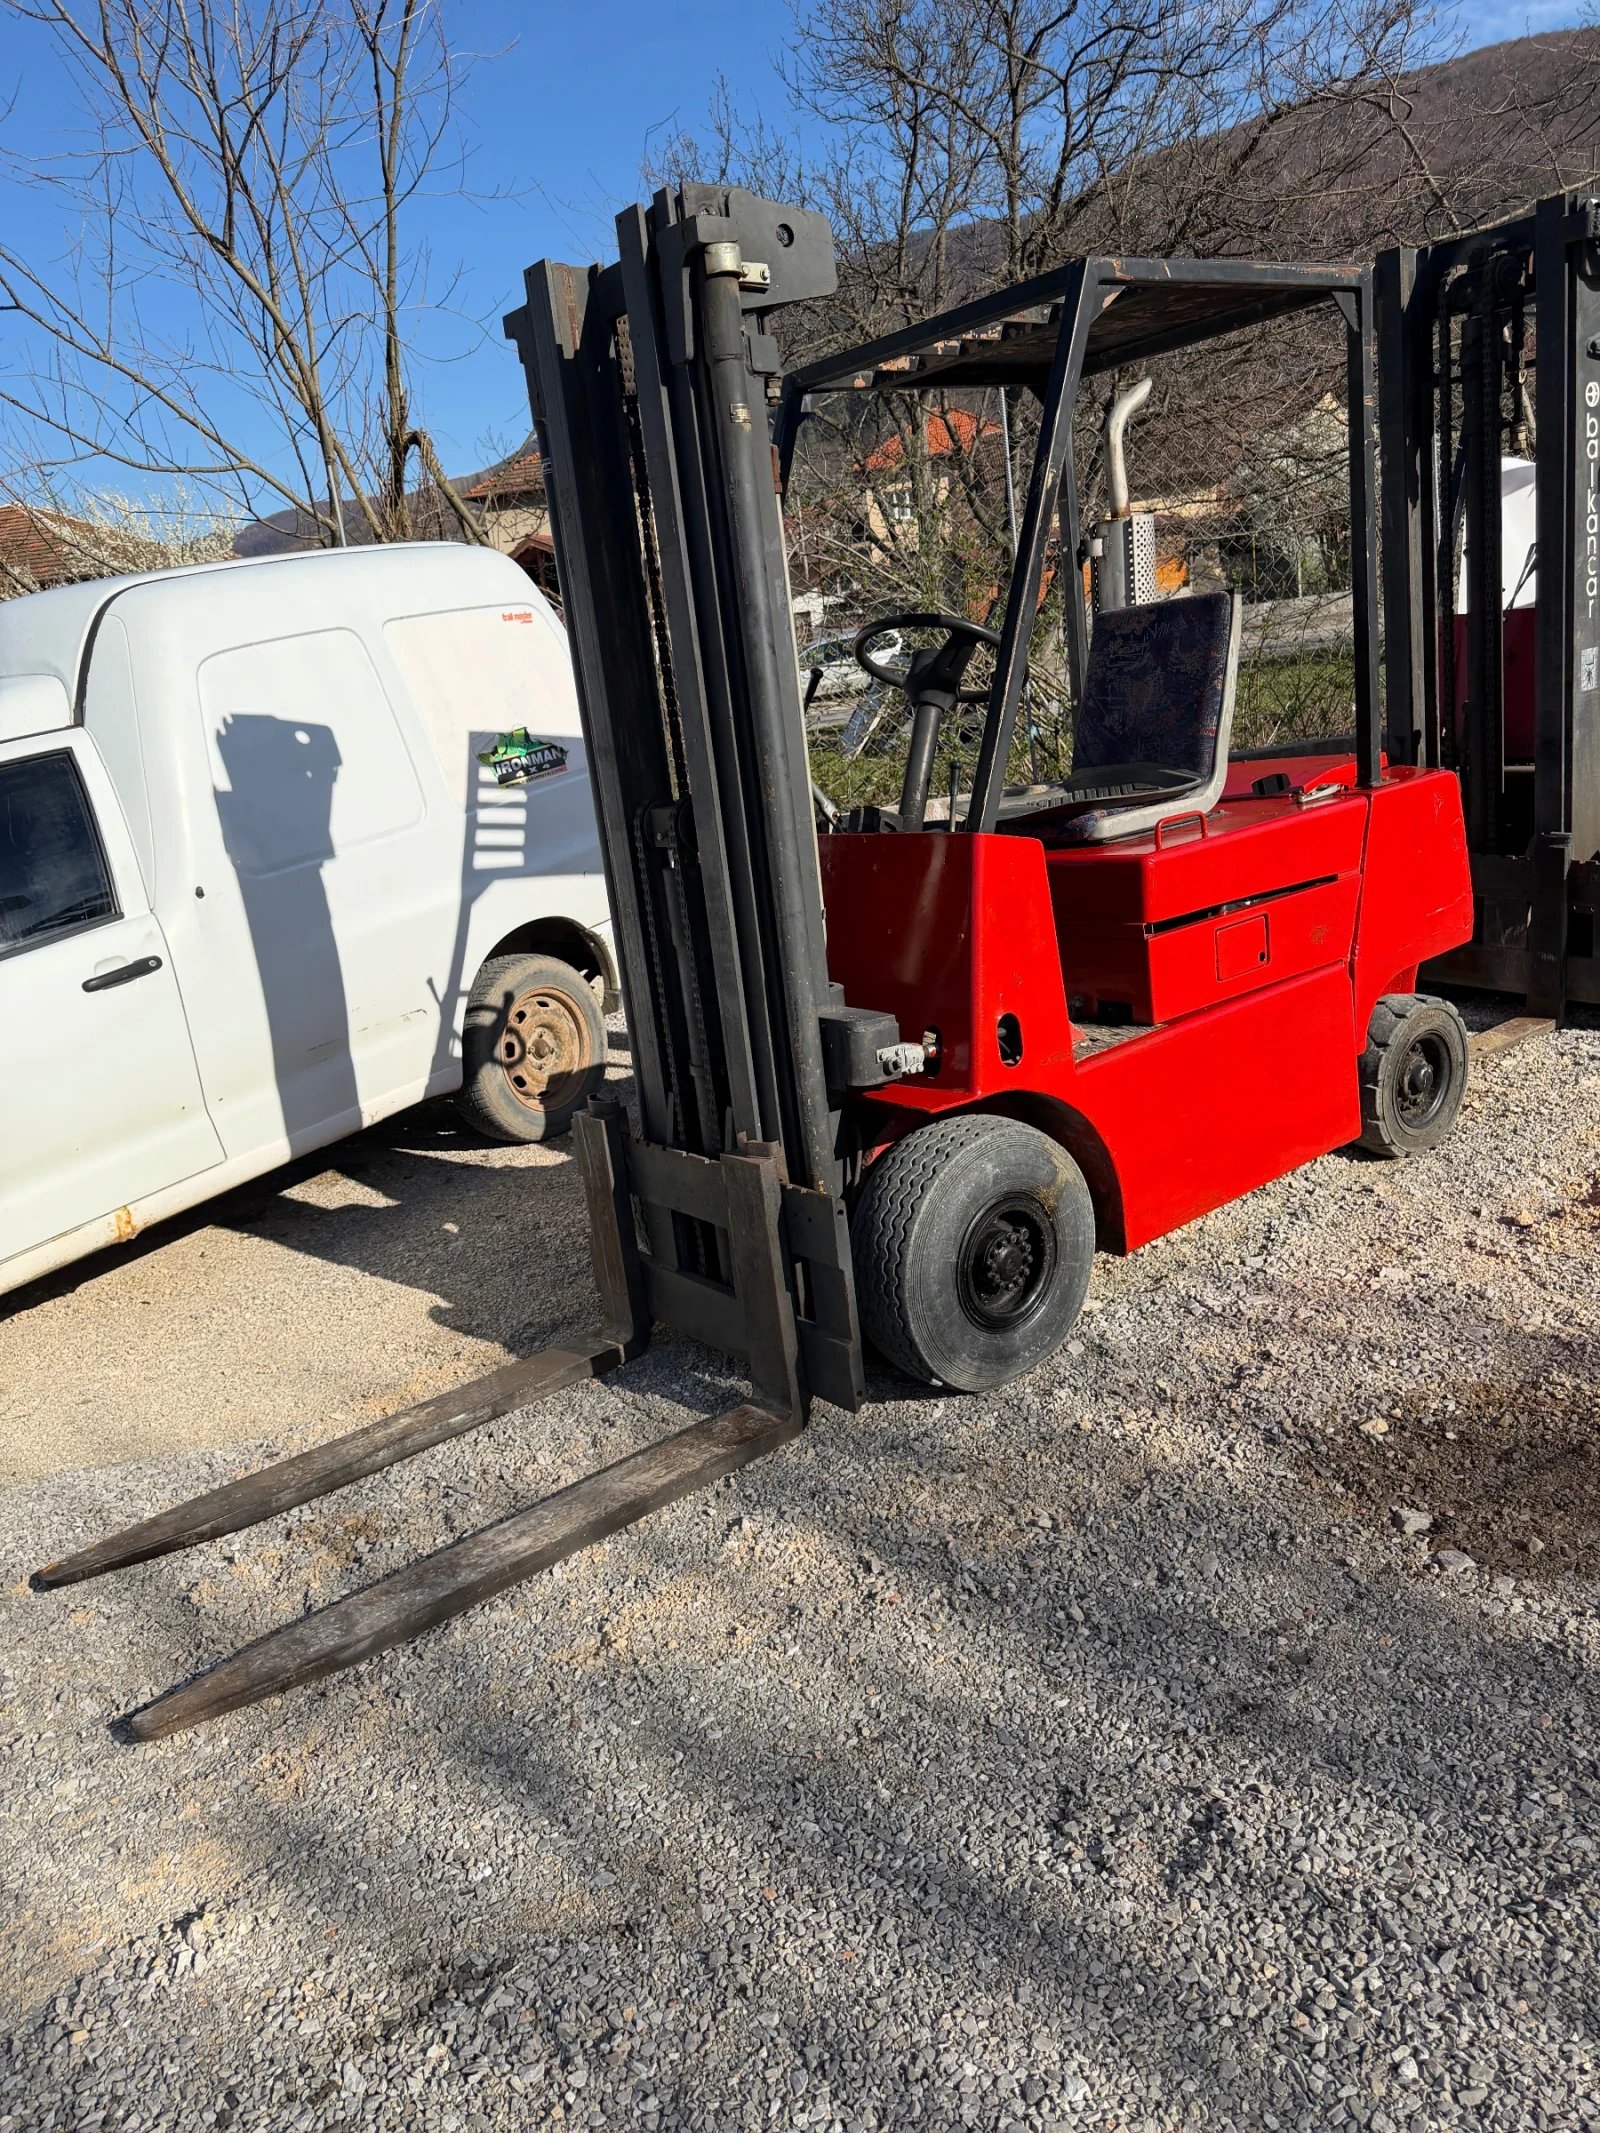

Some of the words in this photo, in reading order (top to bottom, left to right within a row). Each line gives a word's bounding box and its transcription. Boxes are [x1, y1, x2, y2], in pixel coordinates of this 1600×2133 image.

[1585, 412, 1599, 619] balkancar
[495, 747, 563, 777] IRONMAN
[516, 770, 526, 778] 4
